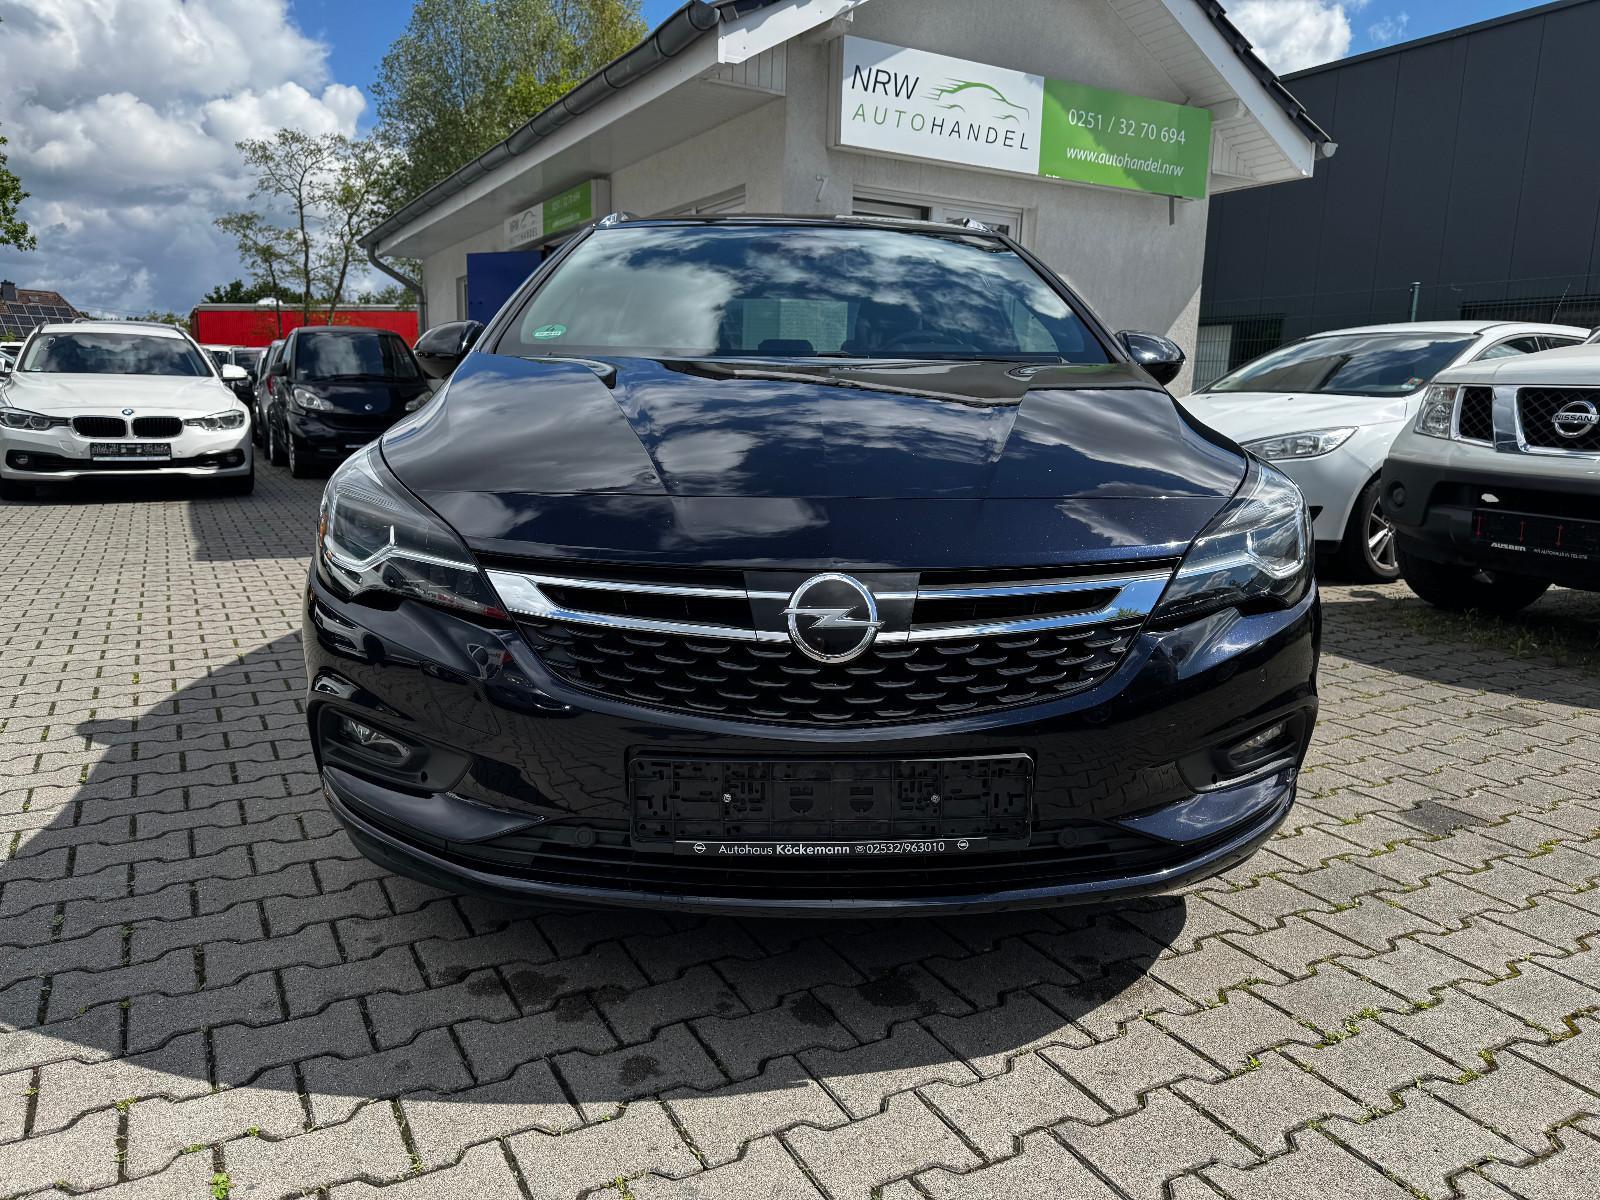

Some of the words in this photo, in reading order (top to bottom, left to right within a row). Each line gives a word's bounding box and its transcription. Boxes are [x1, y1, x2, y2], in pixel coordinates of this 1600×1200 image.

[851, 64, 920, 100] NRW
[852, 103, 1029, 150] AUTOHANDEL
[1068, 109, 1102, 131] 0251
[1108, 116, 1115, 133] /
[1119, 118, 1135, 136] 32
[1140, 122, 1157, 140] 70
[1160, 127, 1186, 145] 694
[1066, 146, 1185, 177] www.autohandel.nrw
[1555, 413, 1593, 423] NISSAN
[718, 844, 773, 855] Autohaus
[776, 843, 850, 855] Köckemann
[866, 842, 945, 854] 02532/963010
